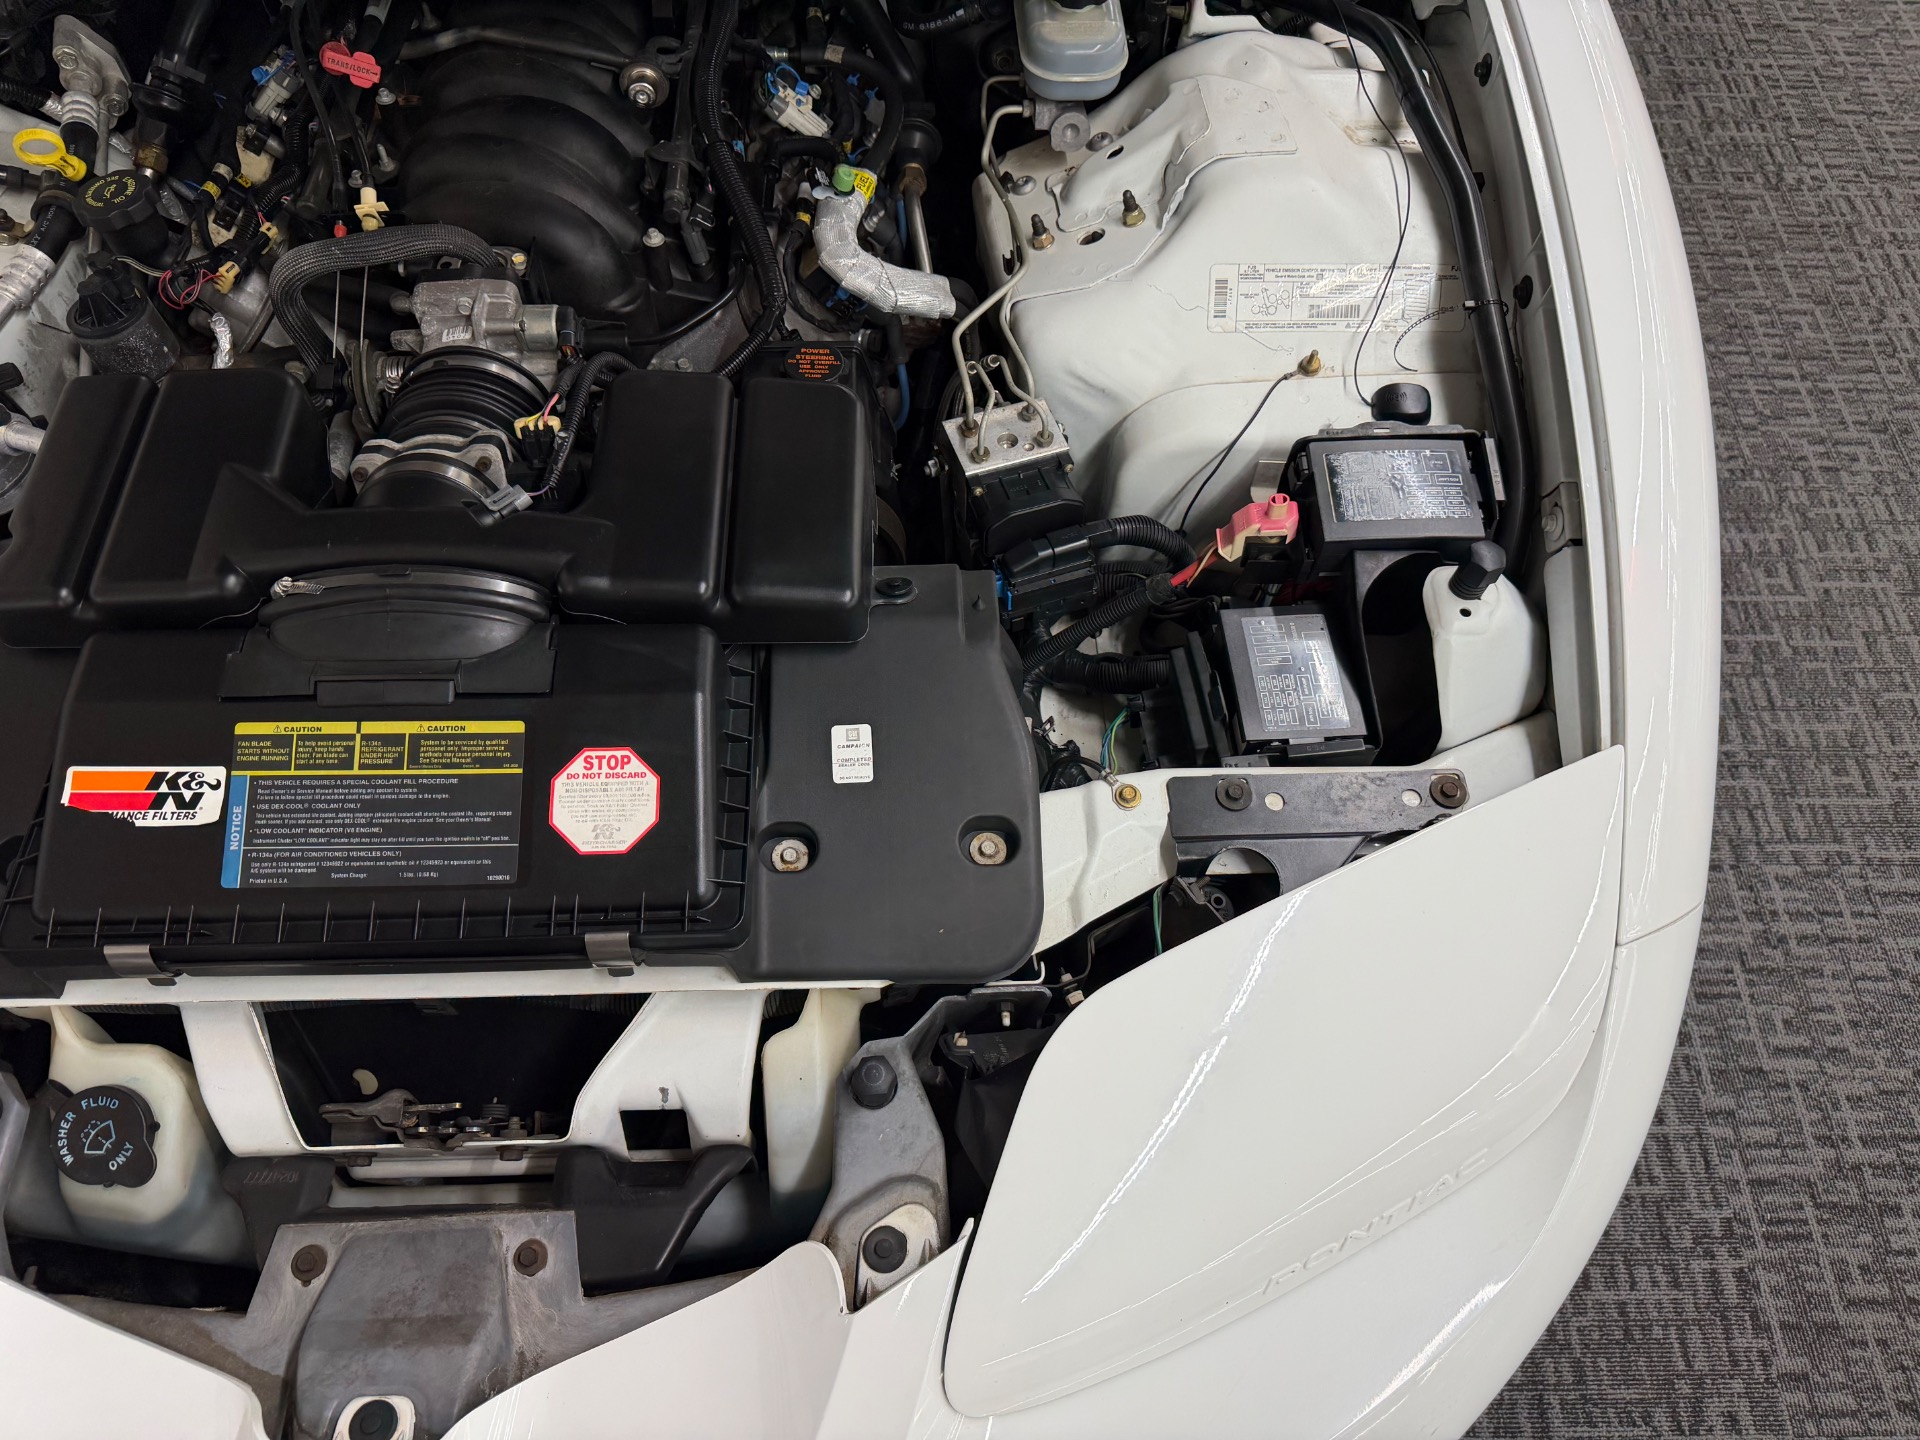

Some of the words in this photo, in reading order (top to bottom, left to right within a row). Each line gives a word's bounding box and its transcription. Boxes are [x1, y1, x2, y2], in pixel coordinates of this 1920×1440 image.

[327, 58, 371, 76] TRANS/LOCK
[856, 176, 870, 191] FUEL
[583, 755, 631, 771] STOP
[144, 771, 221, 810] K&N
[152, 811, 197, 820] FILTERS
[230, 805, 242, 850] NOTICE
[592, 824, 620, 840] K&N
[58, 1112, 76, 1166] WASHER
[81, 1096, 119, 1109] FLUID
[109, 1142, 134, 1170] ONLY
[1262, 1148, 1488, 1295] PONTIAC
